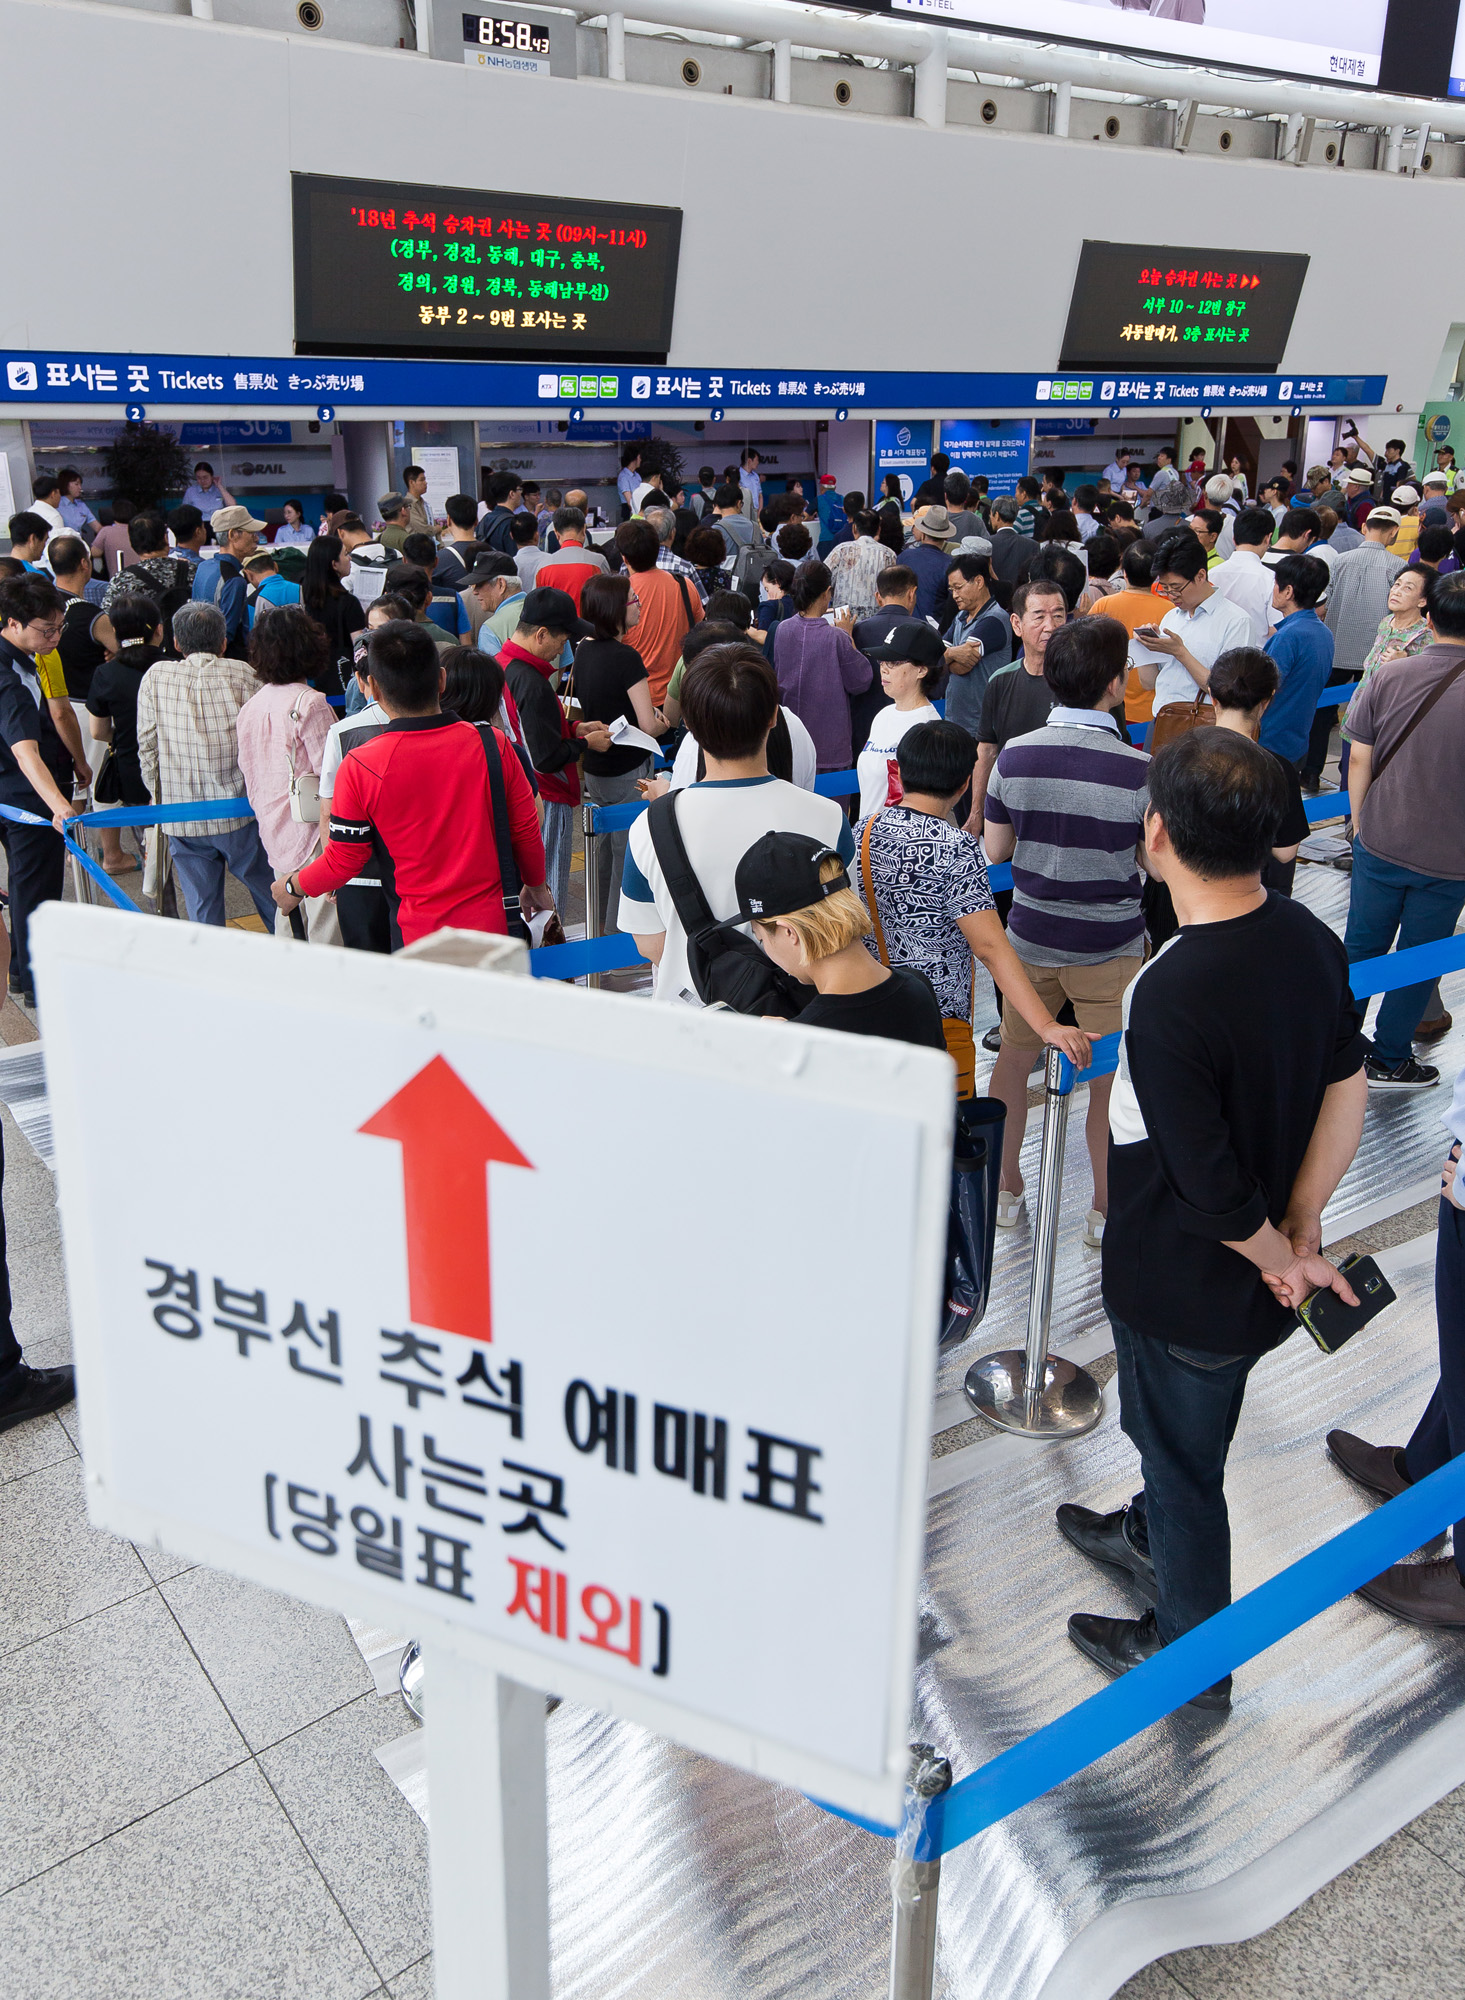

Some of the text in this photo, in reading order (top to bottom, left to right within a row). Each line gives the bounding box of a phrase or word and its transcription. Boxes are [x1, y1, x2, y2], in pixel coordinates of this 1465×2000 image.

[1329, 55, 1366, 77] 현대제철
[351, 208, 647, 248] '18년 추석 승차권 사는 곳 (09시~11시)
[391, 238, 605, 272] (경부, 경전, 동해, 대구, 충북,
[398, 272, 609, 301] 경의, 경원, 경북, 동해남부선)
[1138, 268, 1238, 289] 오늘 승차권 사는 곳
[418, 305, 451, 325] 동부
[456, 308, 468, 325] 2
[490, 309, 515, 328] 9번
[521, 311, 566, 329] 표사는
[572, 313, 587, 330] 곳
[1143, 296, 1166, 314] 서부
[1169, 299, 1184, 314] 10
[1197, 299, 1222, 316] 12번
[1225, 300, 1246, 317] 창구
[1120, 324, 1250, 343] 자동발매기, 3층 표사는 곳
[46, 363, 364, 392] 표사는 곳 Tickets 售票处 きっぷ売り場
[655, 376, 866, 398] 표사는 곳 Tickets 售票处 きっぷ売り場
[1316, 382, 1324, 391] 곳
[1117, 381, 1151, 400] 표사는
[1154, 381, 1166, 400] 곳
[1168, 384, 1199, 398] Tickets
[1203, 384, 1226, 397] 售票处
[231, 462, 286, 476] KORAIL
[144, 1256, 826, 1526] 경부선 추석 예매표
[345, 1412, 570, 1552] 사는곳
